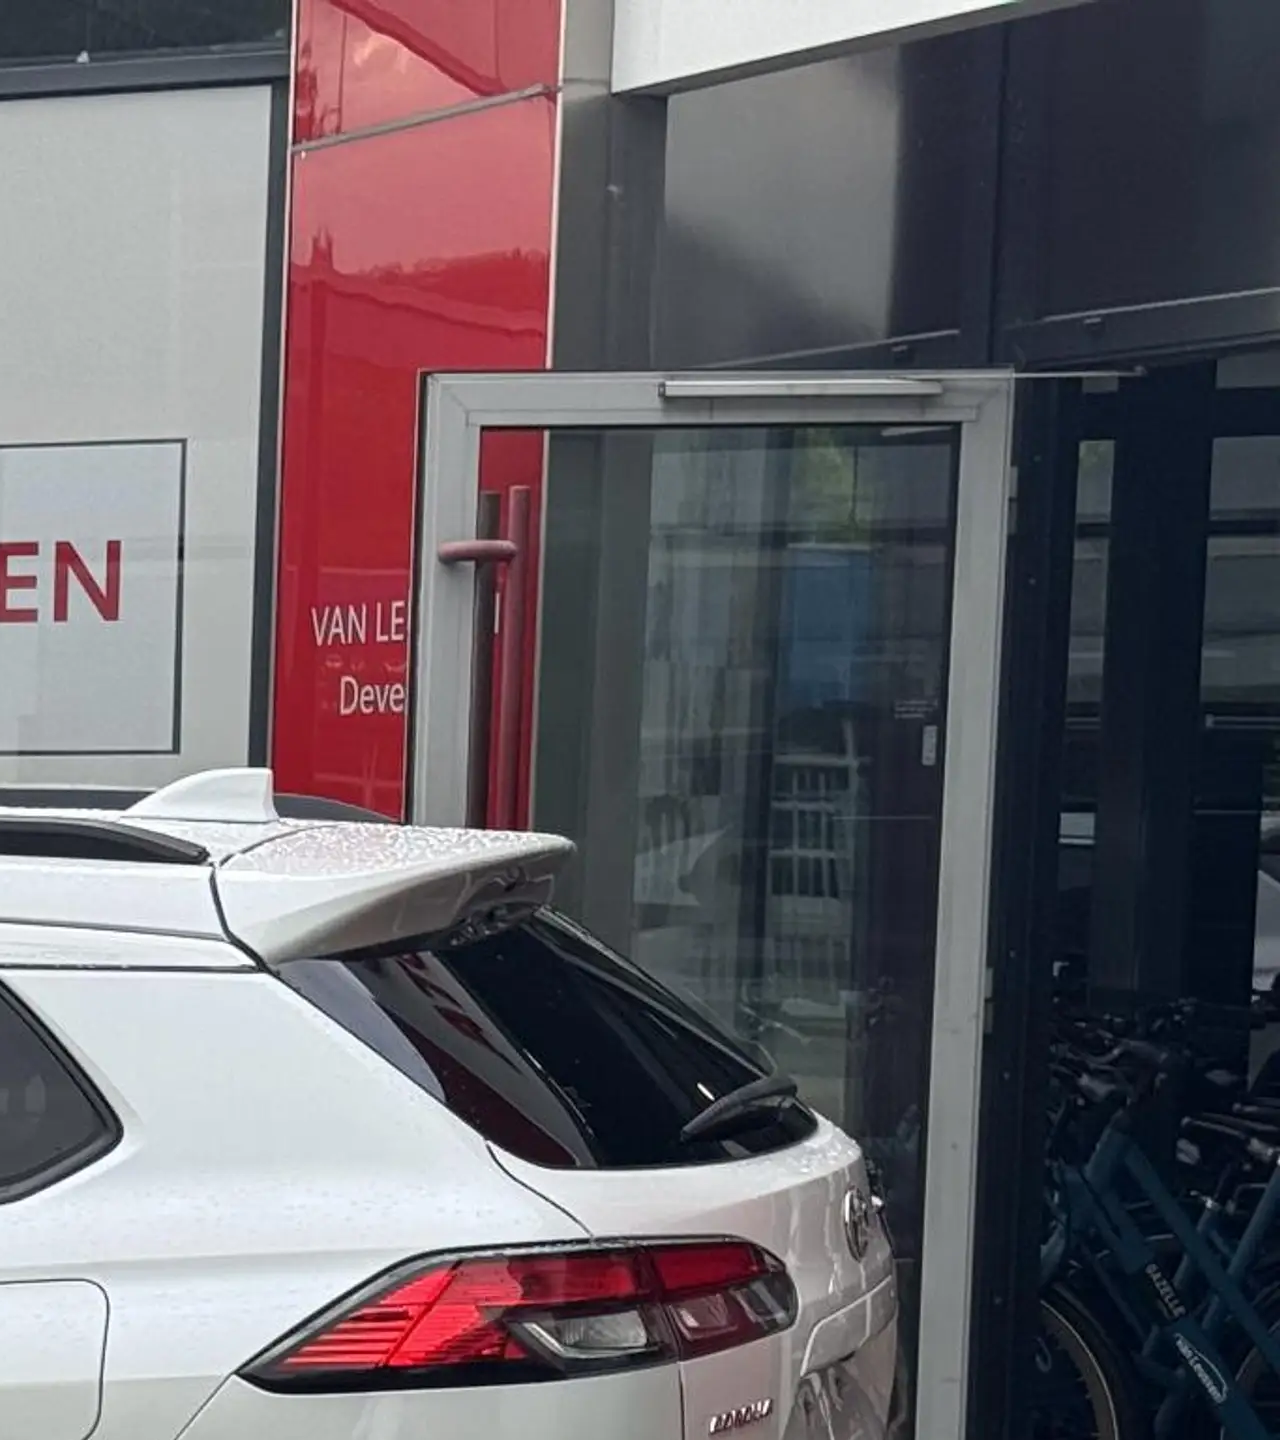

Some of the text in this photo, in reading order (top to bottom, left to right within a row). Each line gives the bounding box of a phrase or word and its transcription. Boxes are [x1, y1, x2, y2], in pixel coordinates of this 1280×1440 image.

[311, 600, 406, 647] VAN LE
[339, 675, 406, 716] Deve
